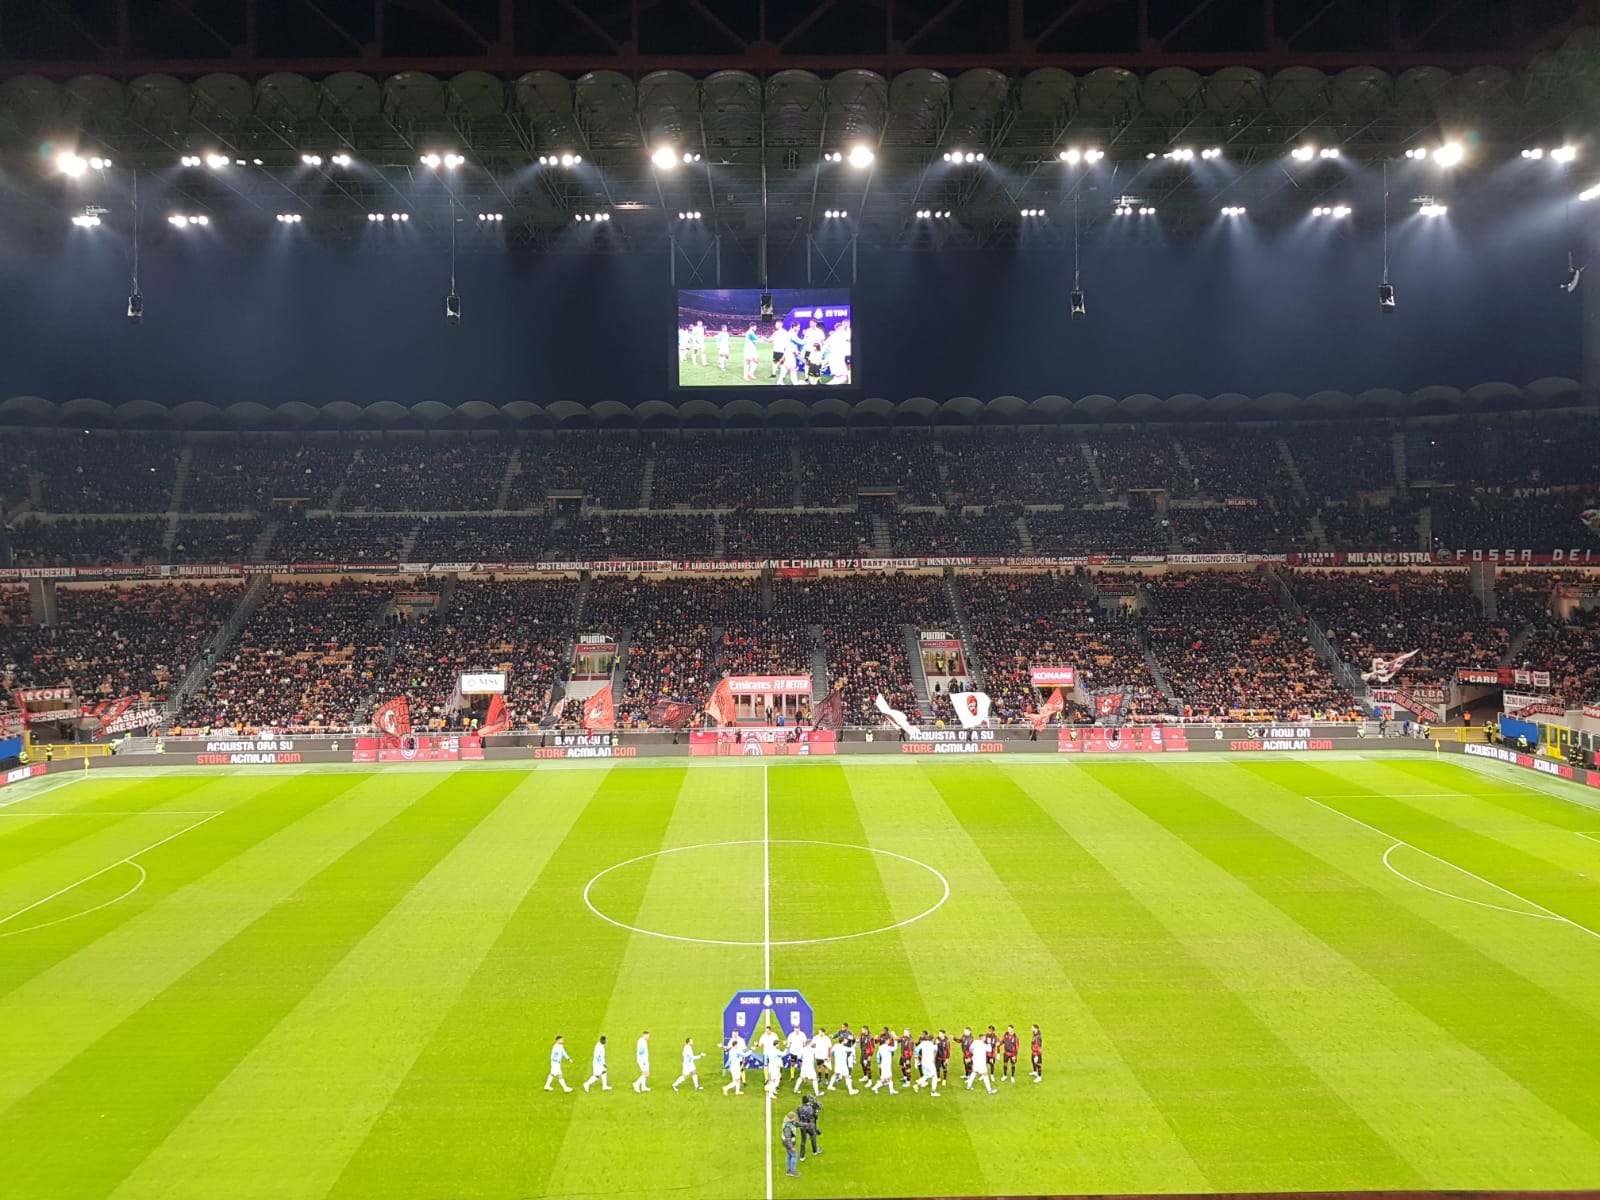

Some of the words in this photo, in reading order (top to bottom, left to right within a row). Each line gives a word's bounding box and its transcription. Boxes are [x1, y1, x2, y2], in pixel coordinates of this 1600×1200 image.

[1348, 552, 1382, 563] MILAN
[1400, 552, 1431, 563] ISTRA
[1456, 549, 1533, 561] FOSSA
[1552, 549, 1592, 561] DEI
[837, 559, 859, 568] 1973
[20, 568, 77, 577] VALTIBERINA
[580, 635, 606, 643] PUMA
[920, 631, 946, 640] PUMA
[1033, 671, 1072, 681] KONAMI
[729, 680, 771, 690] Emirates
[1412, 689, 1445, 699] ALBA
[106, 714, 163, 735] BRESCIANO
[909, 731, 956, 741] ACQUISTA
[980, 731, 994, 740] SU
[206, 741, 254, 752] ACQUISTA
[256, 741, 278, 751] ORA
[280, 741, 293, 750] SU
[740, 996, 761, 1005] SERIE
